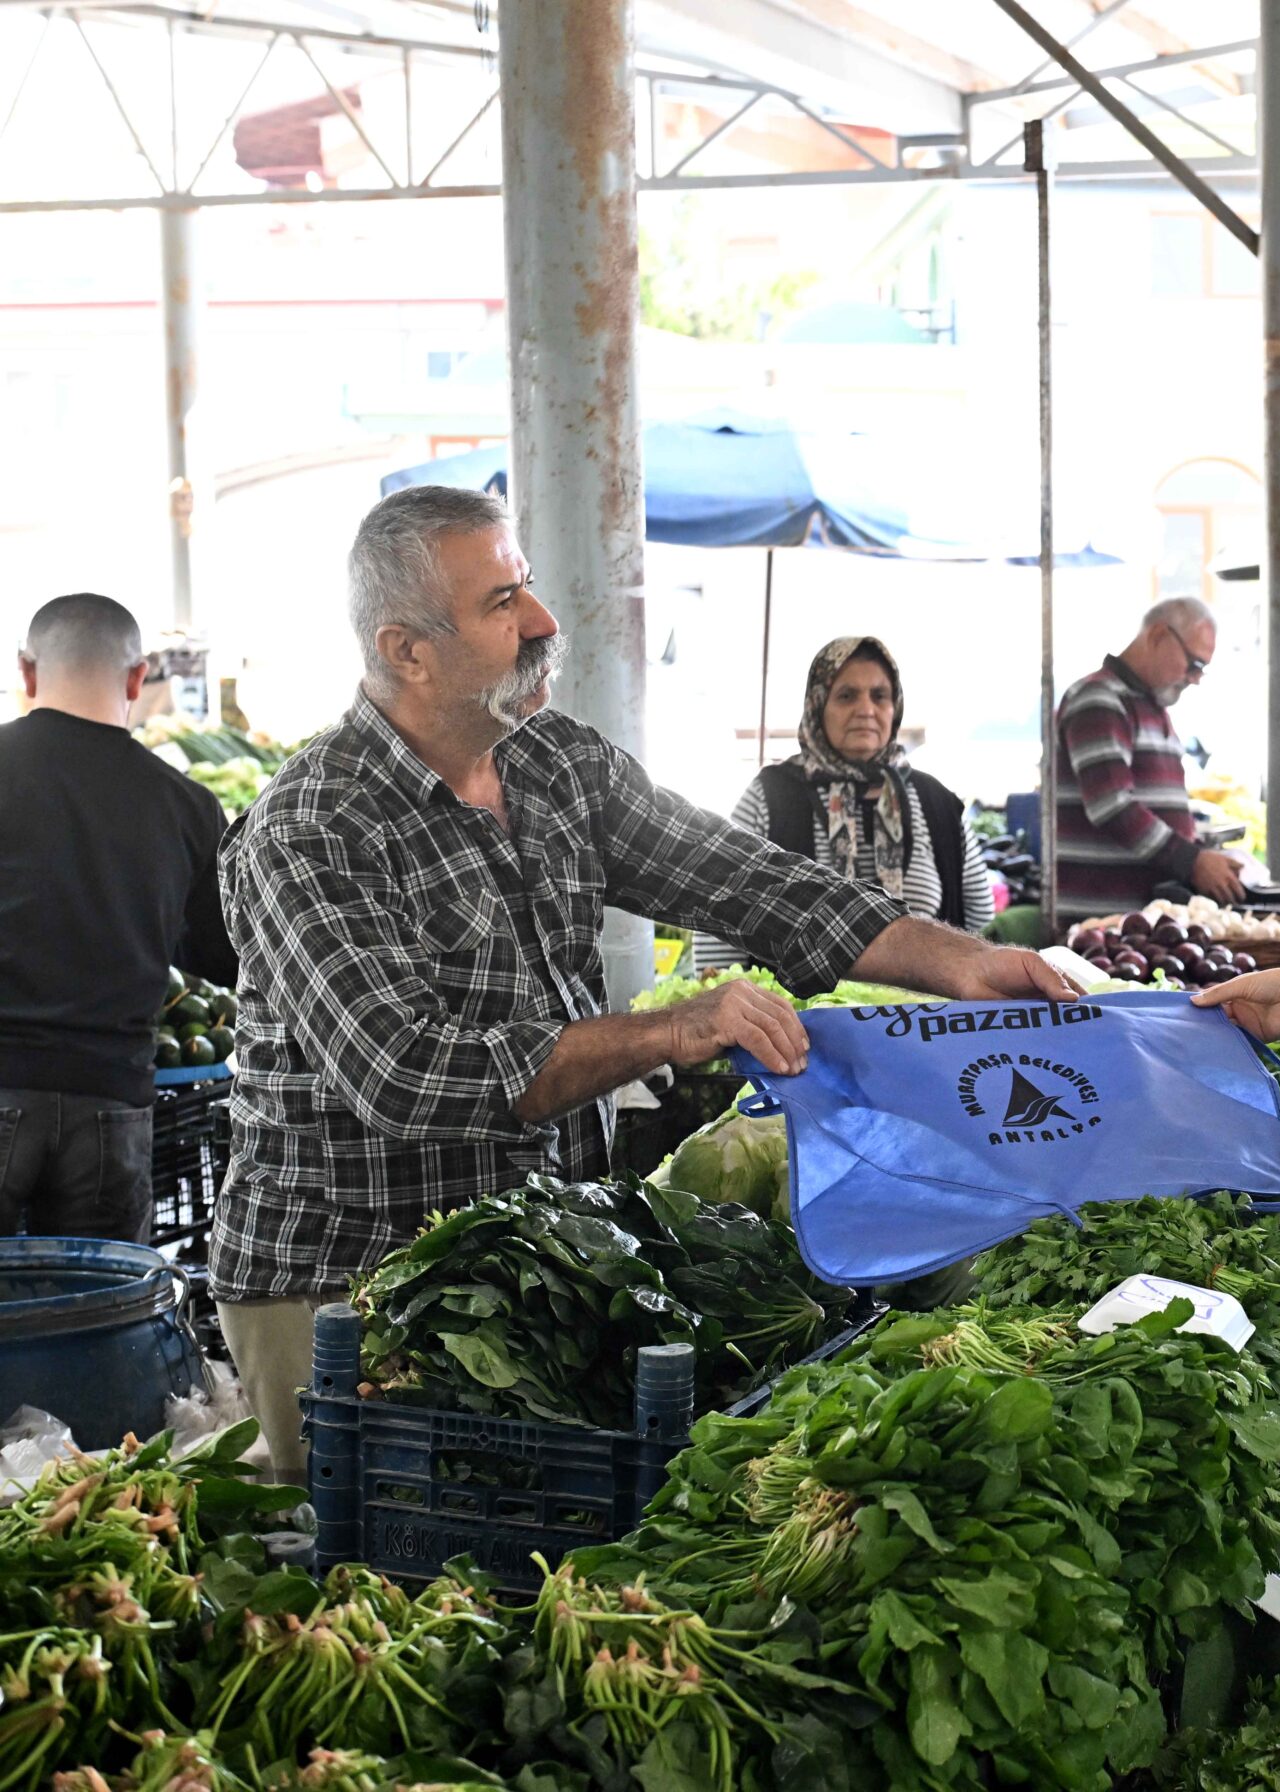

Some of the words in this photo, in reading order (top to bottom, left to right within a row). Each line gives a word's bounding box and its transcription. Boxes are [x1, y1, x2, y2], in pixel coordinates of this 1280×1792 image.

[958, 1053, 1014, 1117] MURATPAŞA
[1018, 1054, 1099, 1104] BELEDİYESİ
[988, 1115, 1102, 1145] ANTALYA
